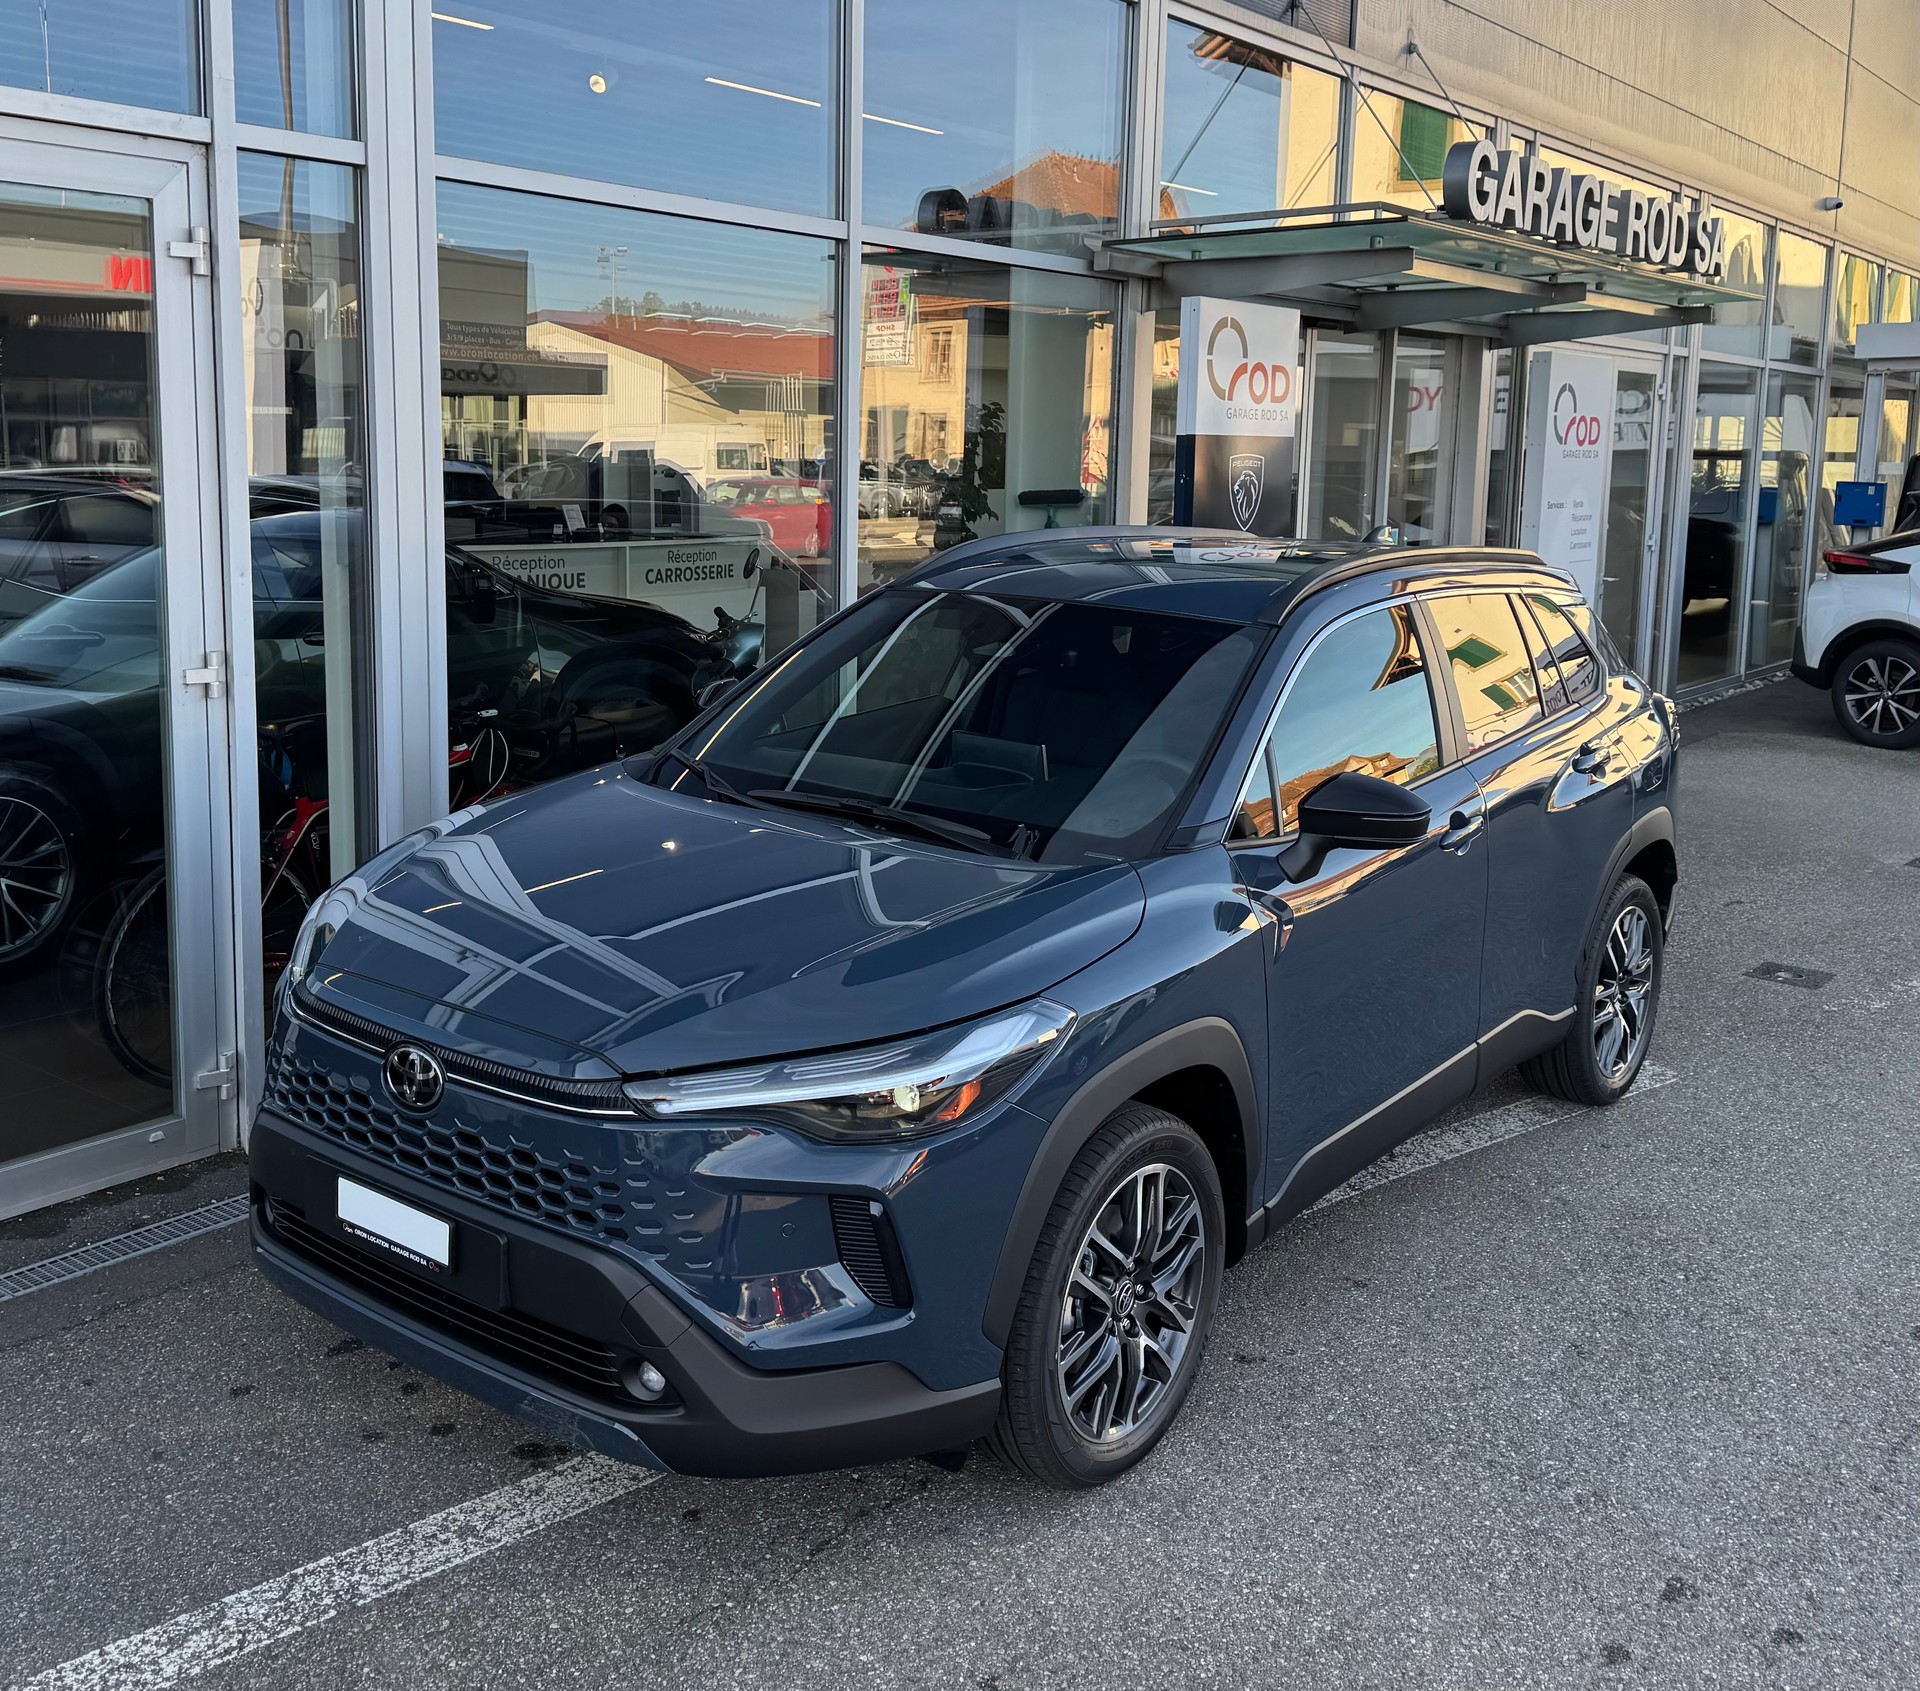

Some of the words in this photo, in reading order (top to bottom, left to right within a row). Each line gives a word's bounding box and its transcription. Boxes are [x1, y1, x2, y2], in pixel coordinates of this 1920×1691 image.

[1467, 139, 1622, 251] GARAGE
[1627, 190, 1689, 266] ROD
[1695, 211, 1727, 276] SA
[1226, 407, 1258, 420] GARAGE
[1261, 409, 1278, 421] ROD
[1280, 410, 1289, 421] SA
[1562, 449, 1581, 459] GARAGE
[1232, 460, 1262, 468] PEUGEOT
[492, 554, 565, 573] Réception
[667, 548, 717, 565] Réception
[645, 563, 734, 584] CARROSSERIE
[367, 1234, 389, 1249] LOCATION
[390, 1244, 410, 1259] GARAGE
[409, 1253, 420, 1263] ROD
